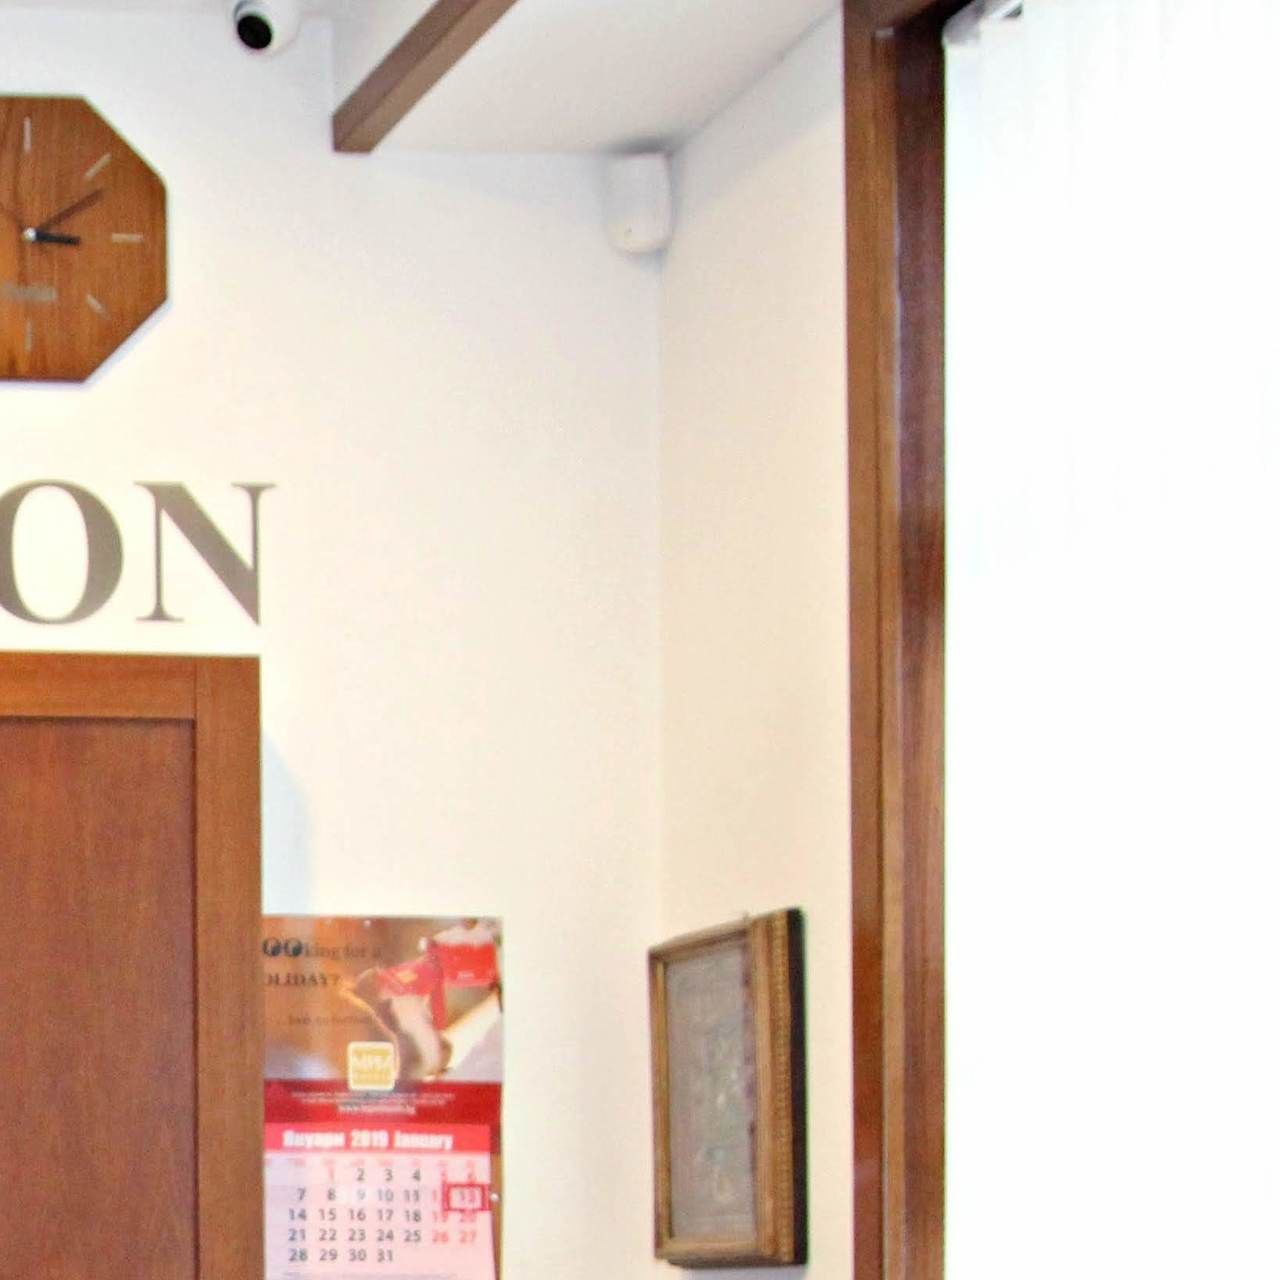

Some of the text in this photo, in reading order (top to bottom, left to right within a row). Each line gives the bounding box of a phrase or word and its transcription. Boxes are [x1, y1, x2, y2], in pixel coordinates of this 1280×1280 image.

[350, 1129, 389, 1148] 2019
[394, 1130, 454, 1150] January
[357, 1167, 365, 1181] 2
[385, 1168, 393, 1182] 3
[412, 1168, 421, 1182] 4
[297, 1188, 306, 1201] 7
[327, 1188, 336, 1201] 8
[357, 1188, 365, 1201] 9
[377, 1188, 394, 1201] 10
[404, 1189, 420, 1202] 11
[289, 1208, 307, 1221] 14
[319, 1208, 337, 1221] 15
[349, 1208, 366, 1221] 16
[377, 1208, 394, 1221] 17
[405, 1208, 422, 1222] 18
[288, 1229, 477, 1243] 21 22 23 24 25 26 27
[289, 1249, 394, 1262] 28 29 30 31
